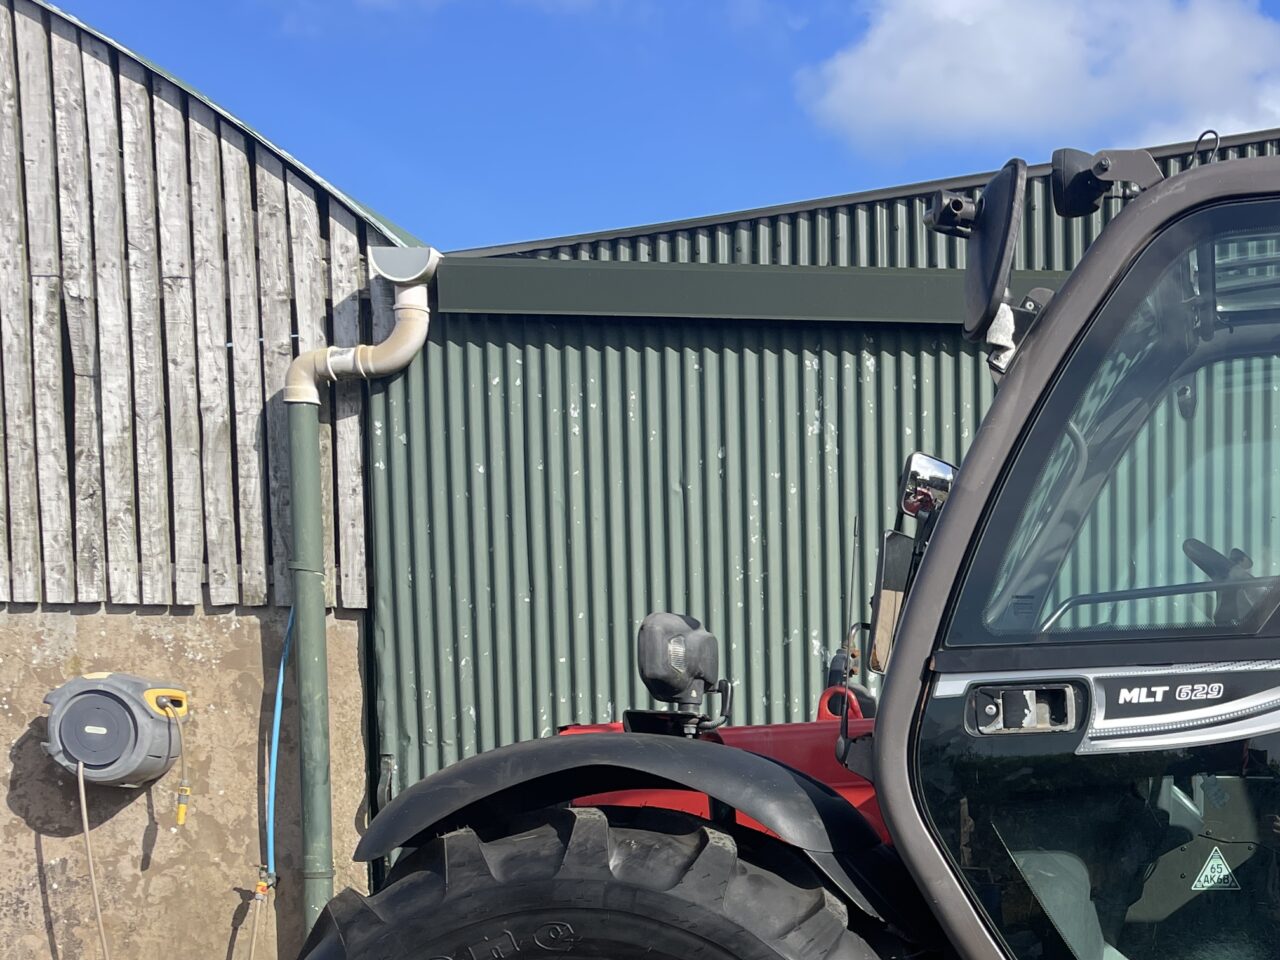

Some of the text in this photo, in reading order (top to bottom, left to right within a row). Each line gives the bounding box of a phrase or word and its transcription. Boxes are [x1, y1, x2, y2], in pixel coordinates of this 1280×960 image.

[1118, 683, 1224, 704] MLT 629
[1210, 864, 1223, 874] 65
